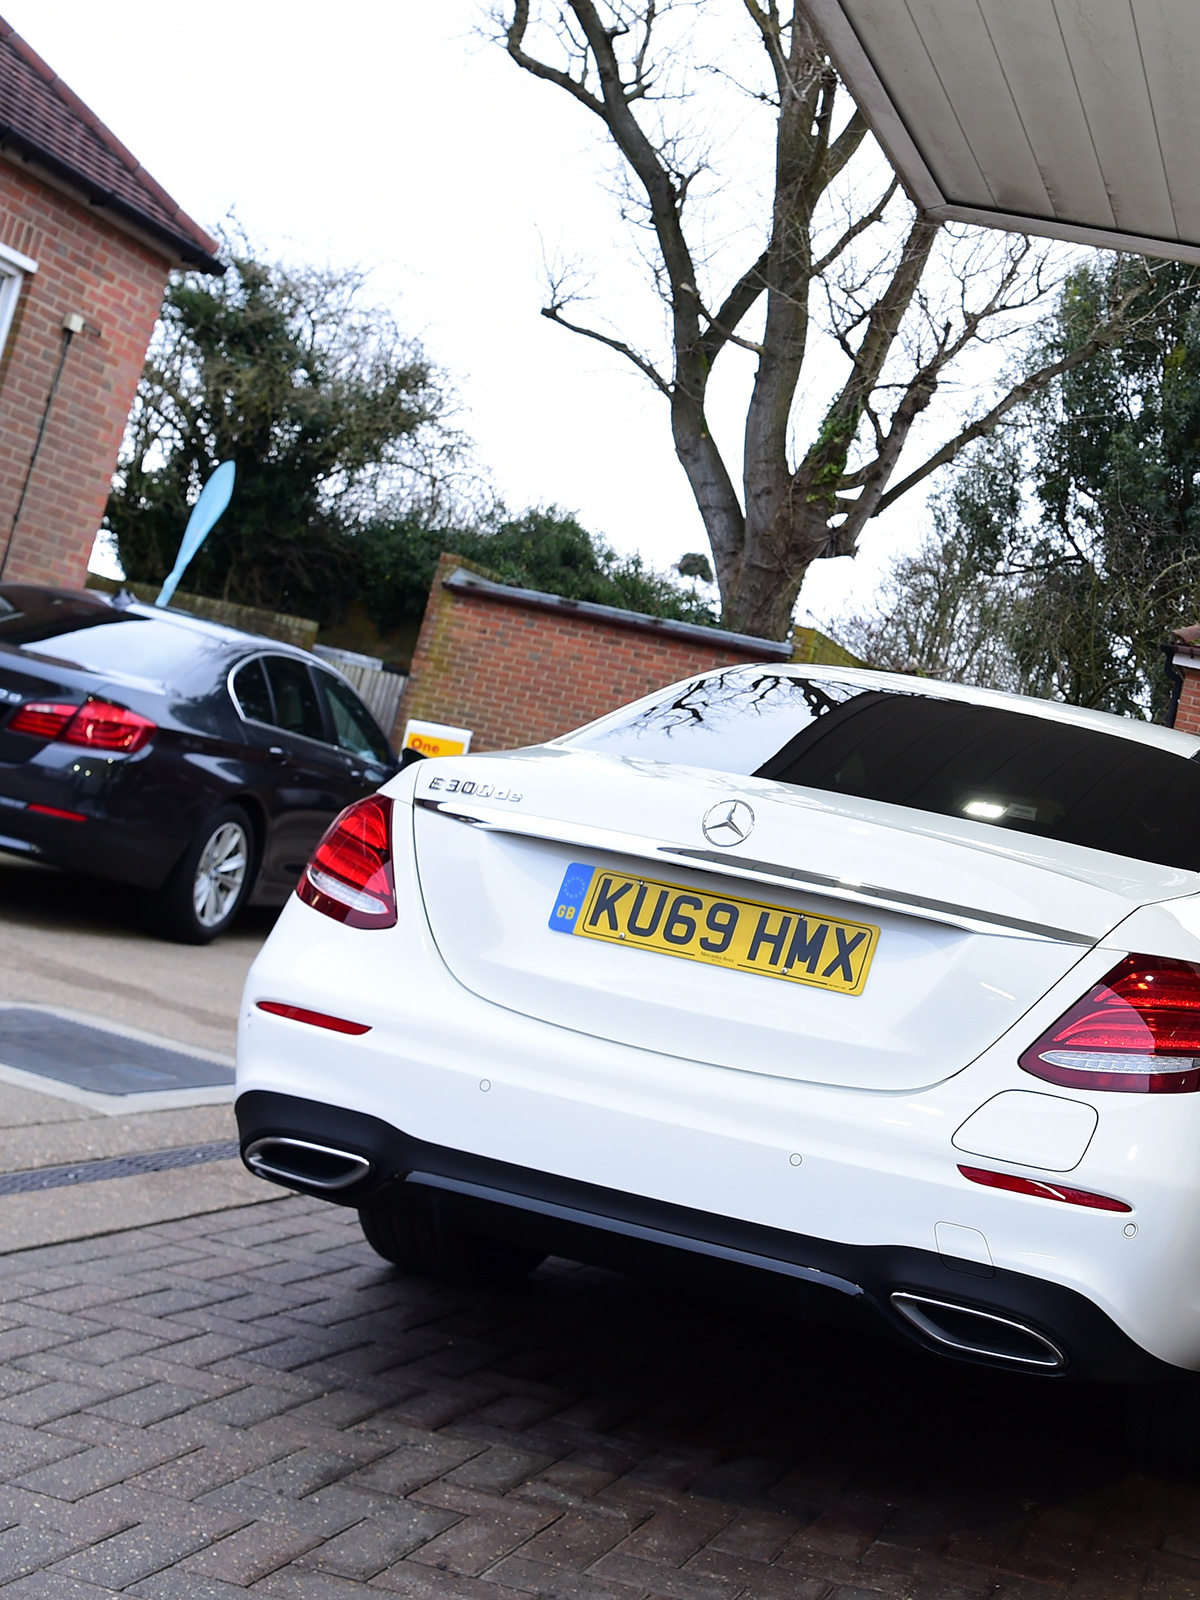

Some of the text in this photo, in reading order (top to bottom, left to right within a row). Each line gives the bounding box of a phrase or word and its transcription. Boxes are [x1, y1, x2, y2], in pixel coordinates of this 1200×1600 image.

[411, 737, 440, 754] One
[428, 776, 446, 791] E
[556, 904, 576, 920] GB
[588, 877, 868, 984] KU69 HMX
